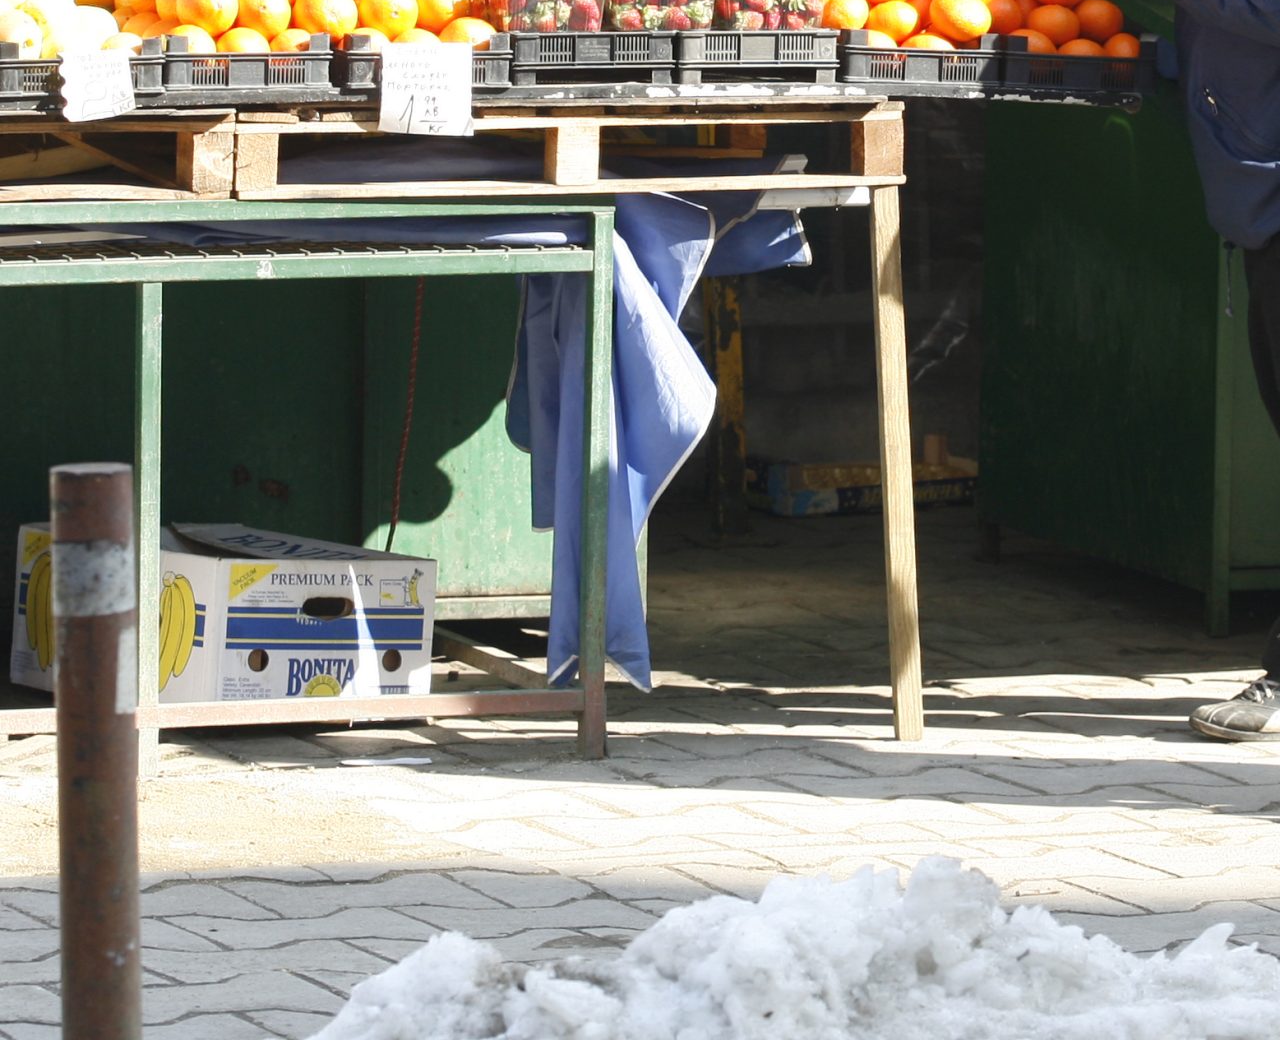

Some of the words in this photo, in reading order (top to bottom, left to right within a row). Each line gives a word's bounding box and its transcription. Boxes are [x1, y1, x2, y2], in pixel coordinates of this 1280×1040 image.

[232, 567, 257, 586] VACUUM
[240, 576, 256, 590] PACK
[271, 573, 336, 586] PREMIUM
[340, 573, 374, 587] PACK
[286, 658, 356, 697] BONITA
